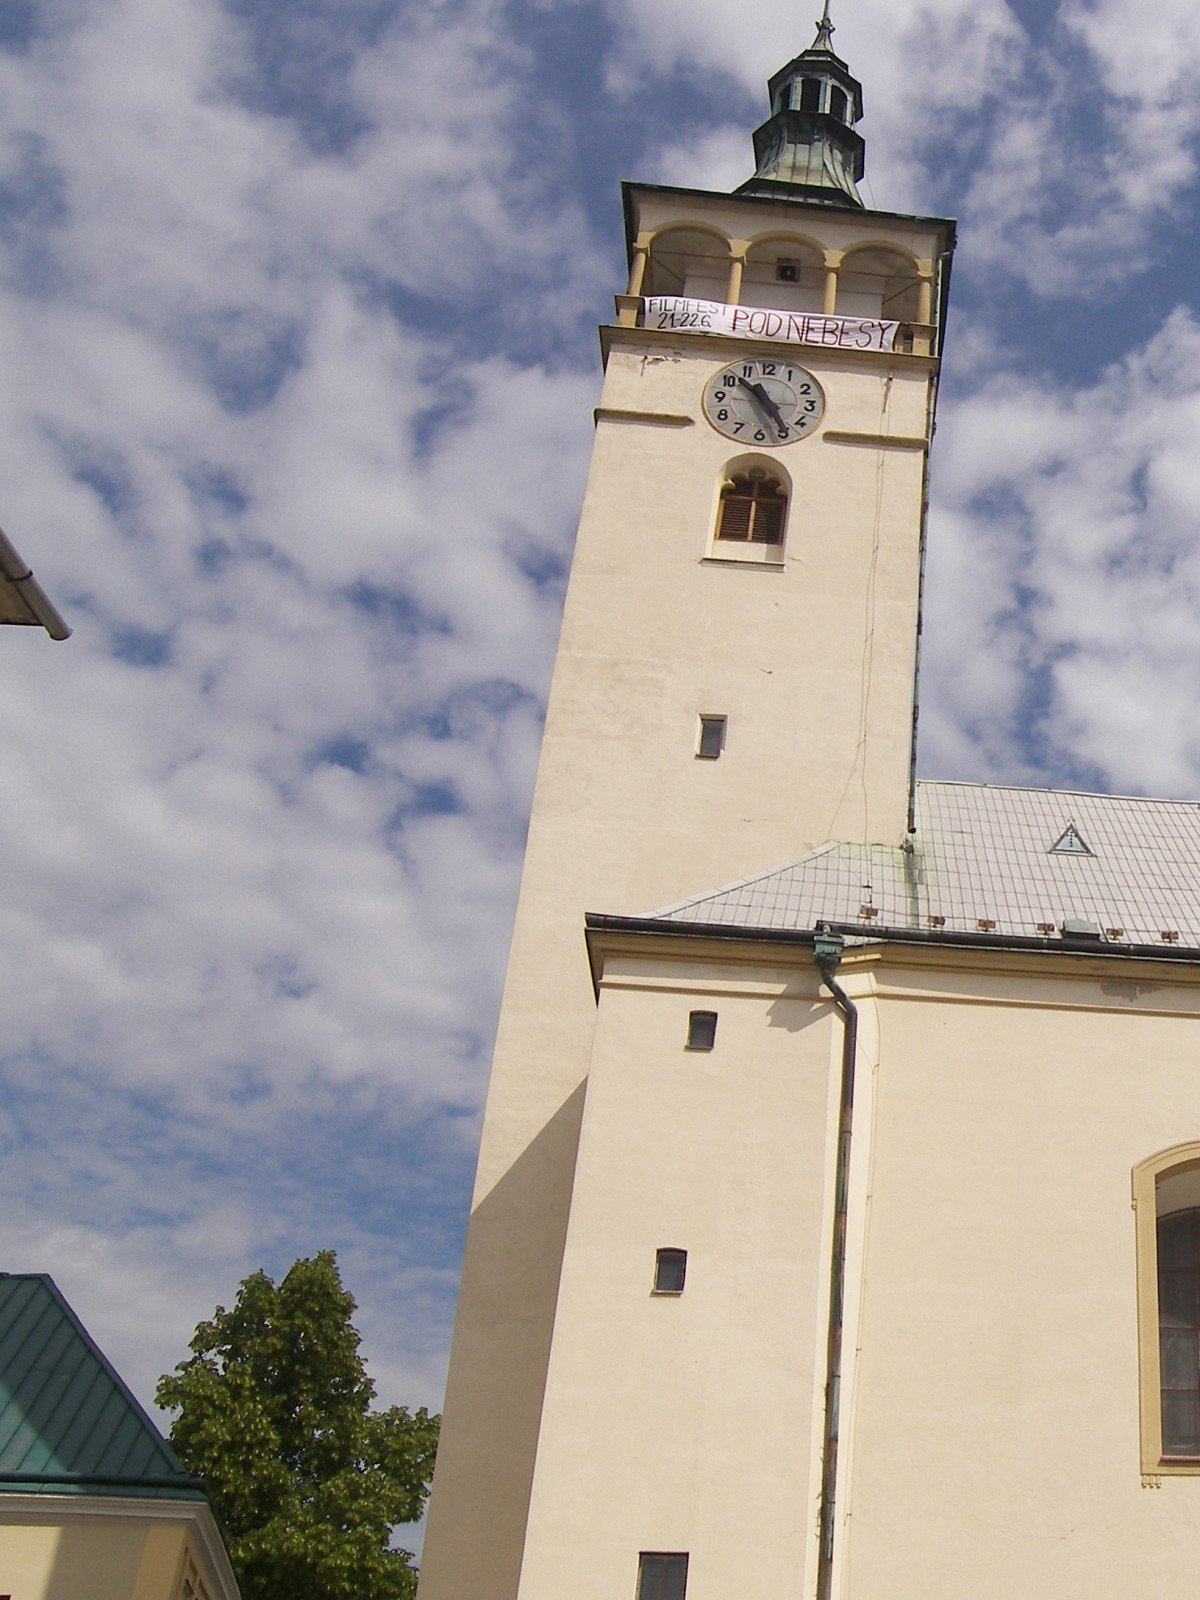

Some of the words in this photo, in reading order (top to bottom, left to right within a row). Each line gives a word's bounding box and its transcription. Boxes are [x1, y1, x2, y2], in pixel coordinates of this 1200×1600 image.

[648, 298, 730, 316] FILMFEST
[732, 309, 783, 337] POD
[786, 314, 894, 349] NEBESY
[743, 365, 753, 378] 11
[762, 363, 776, 376] 12
[787, 369, 793, 382] 1
[723, 374, 736, 388] 10
[800, 383, 811, 395] 2
[714, 391, 726, 403] 9
[804, 399, 816, 412] 3
[717, 409, 728, 421] 8
[794, 415, 807, 428] 4
[733, 421, 745, 434] 7
[754, 429, 765, 441] 6
